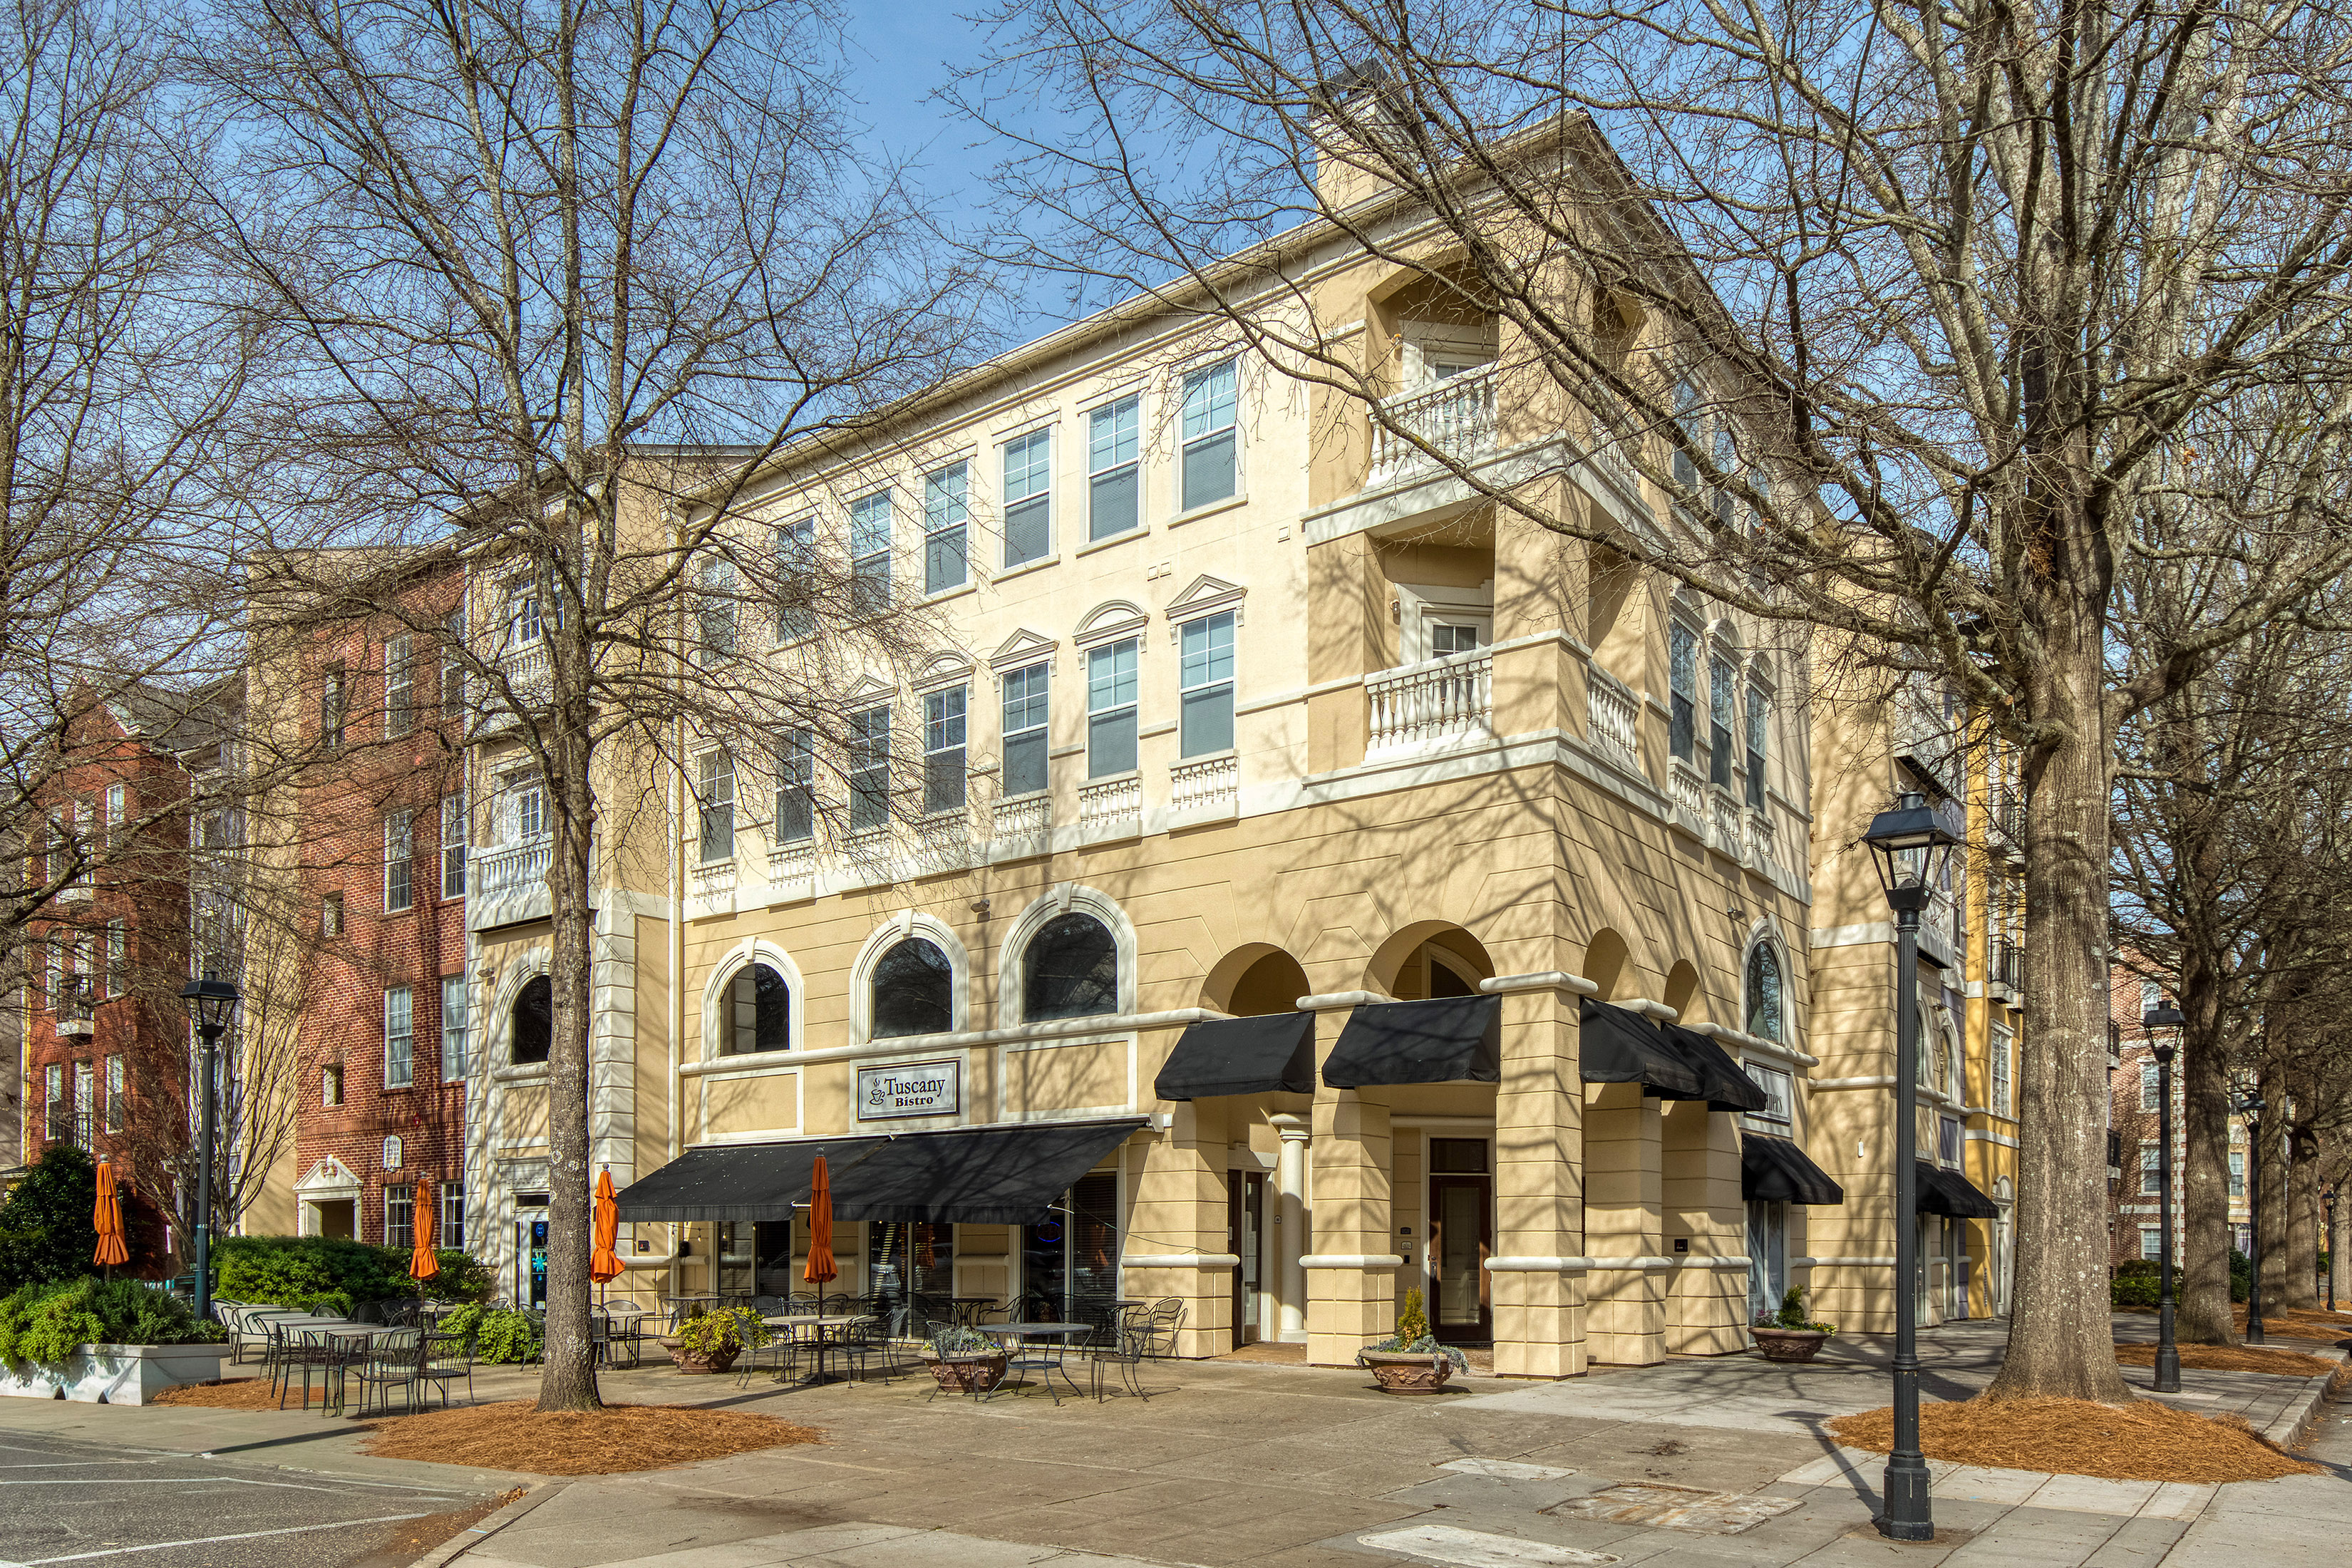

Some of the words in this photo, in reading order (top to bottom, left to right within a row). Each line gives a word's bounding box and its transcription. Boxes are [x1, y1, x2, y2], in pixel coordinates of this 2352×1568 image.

[884, 1077, 945, 1097] Tuscany
[895, 1096, 934, 1107] Bistro
[1765, 1092, 1783, 1113] aners
